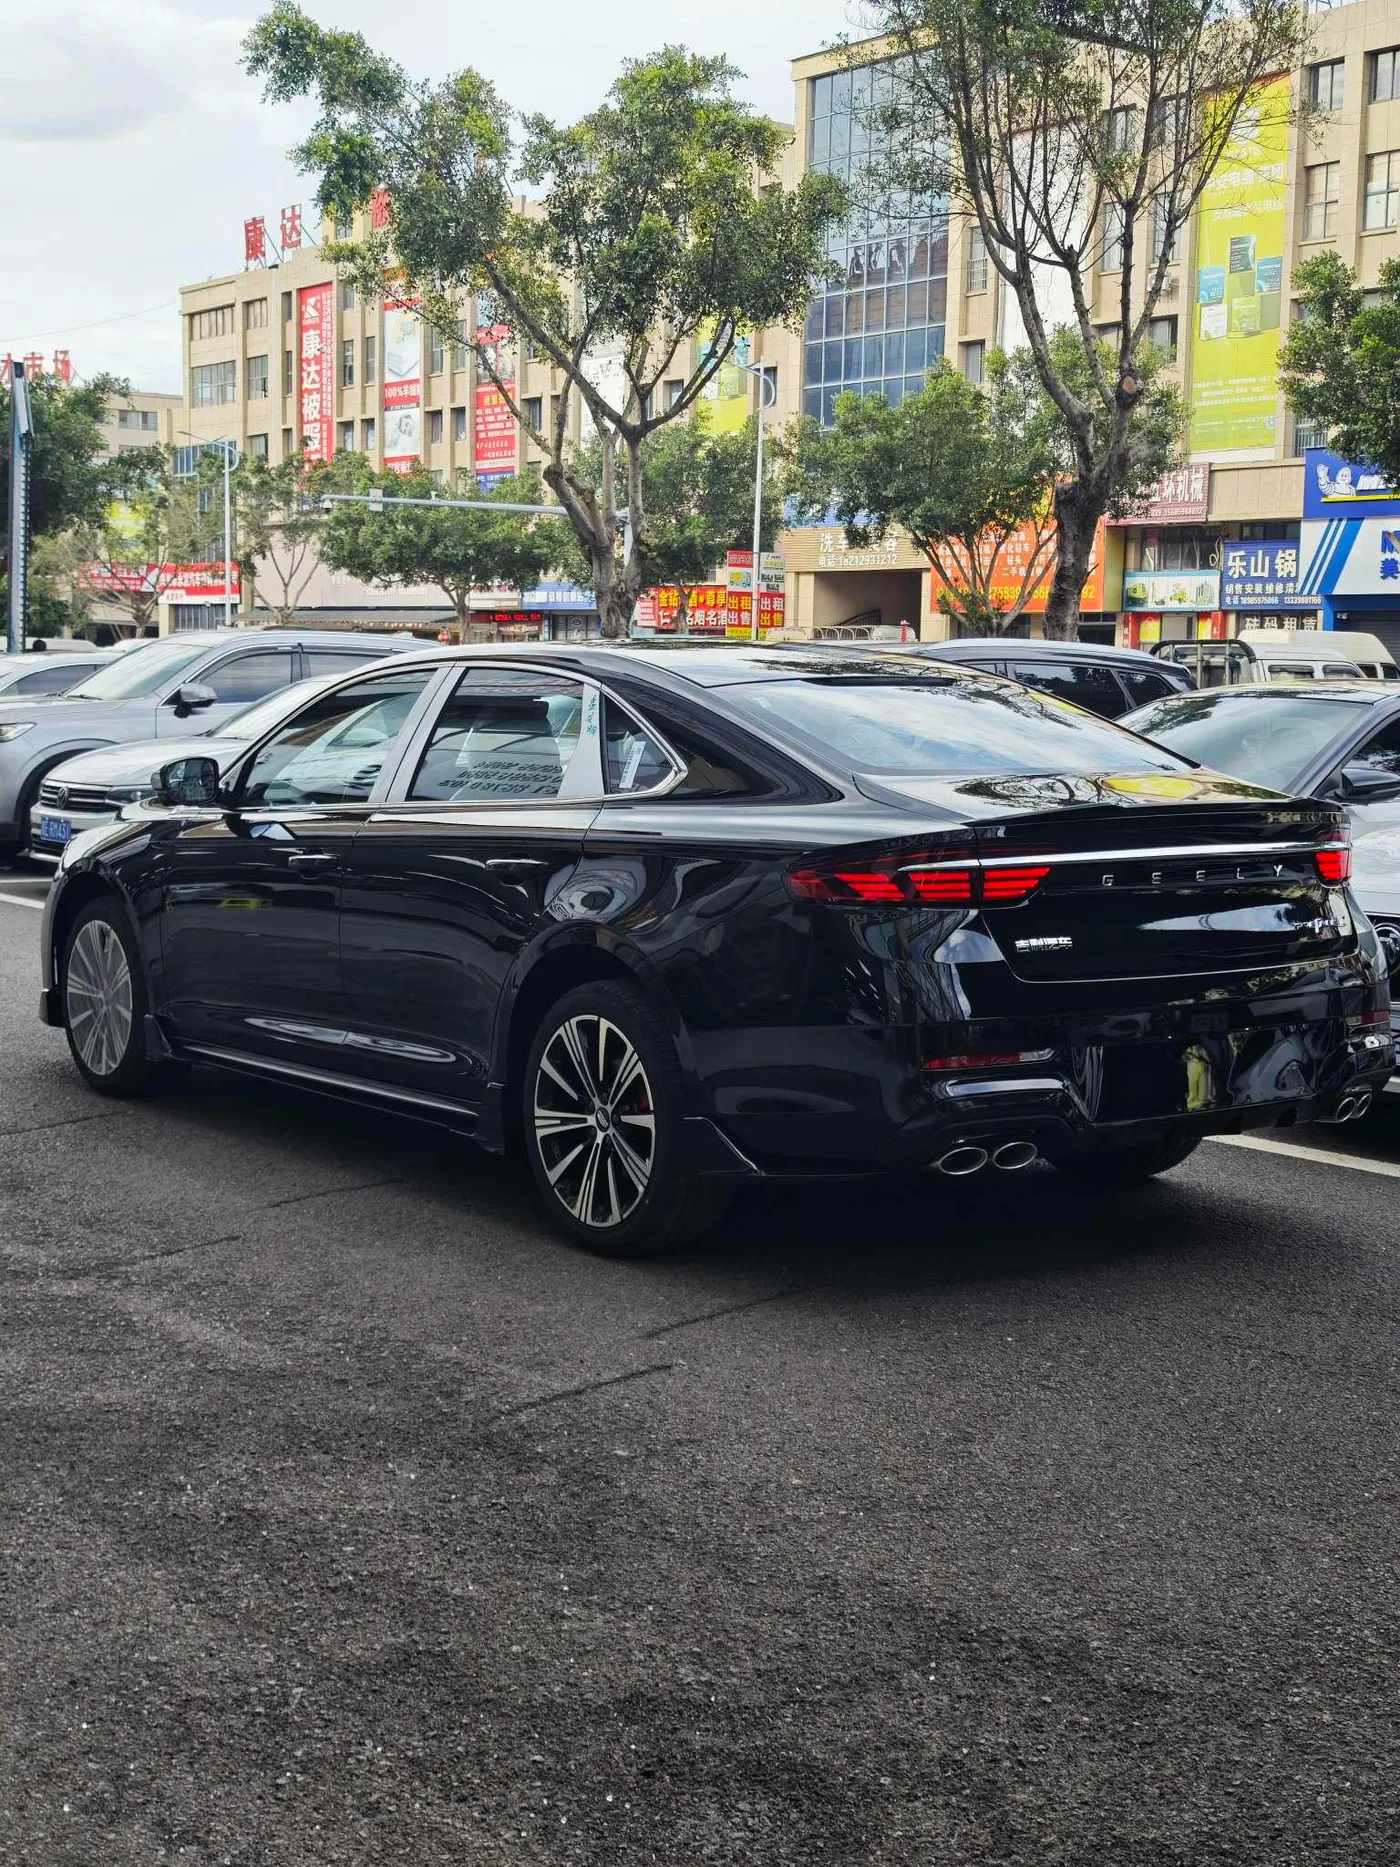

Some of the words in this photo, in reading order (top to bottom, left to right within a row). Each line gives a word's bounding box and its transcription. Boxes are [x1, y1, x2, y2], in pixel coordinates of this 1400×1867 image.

[1228, 549, 1297, 579] 乐山锅
[728, 595, 752, 610] 出租
[760, 596, 784, 611] 出租
[659, 609, 728, 627] 仁名烟名酒
[728, 610, 752, 626] 出售
[760, 611, 784, 627] 出售
[1102, 864, 1283, 887] GEELY
